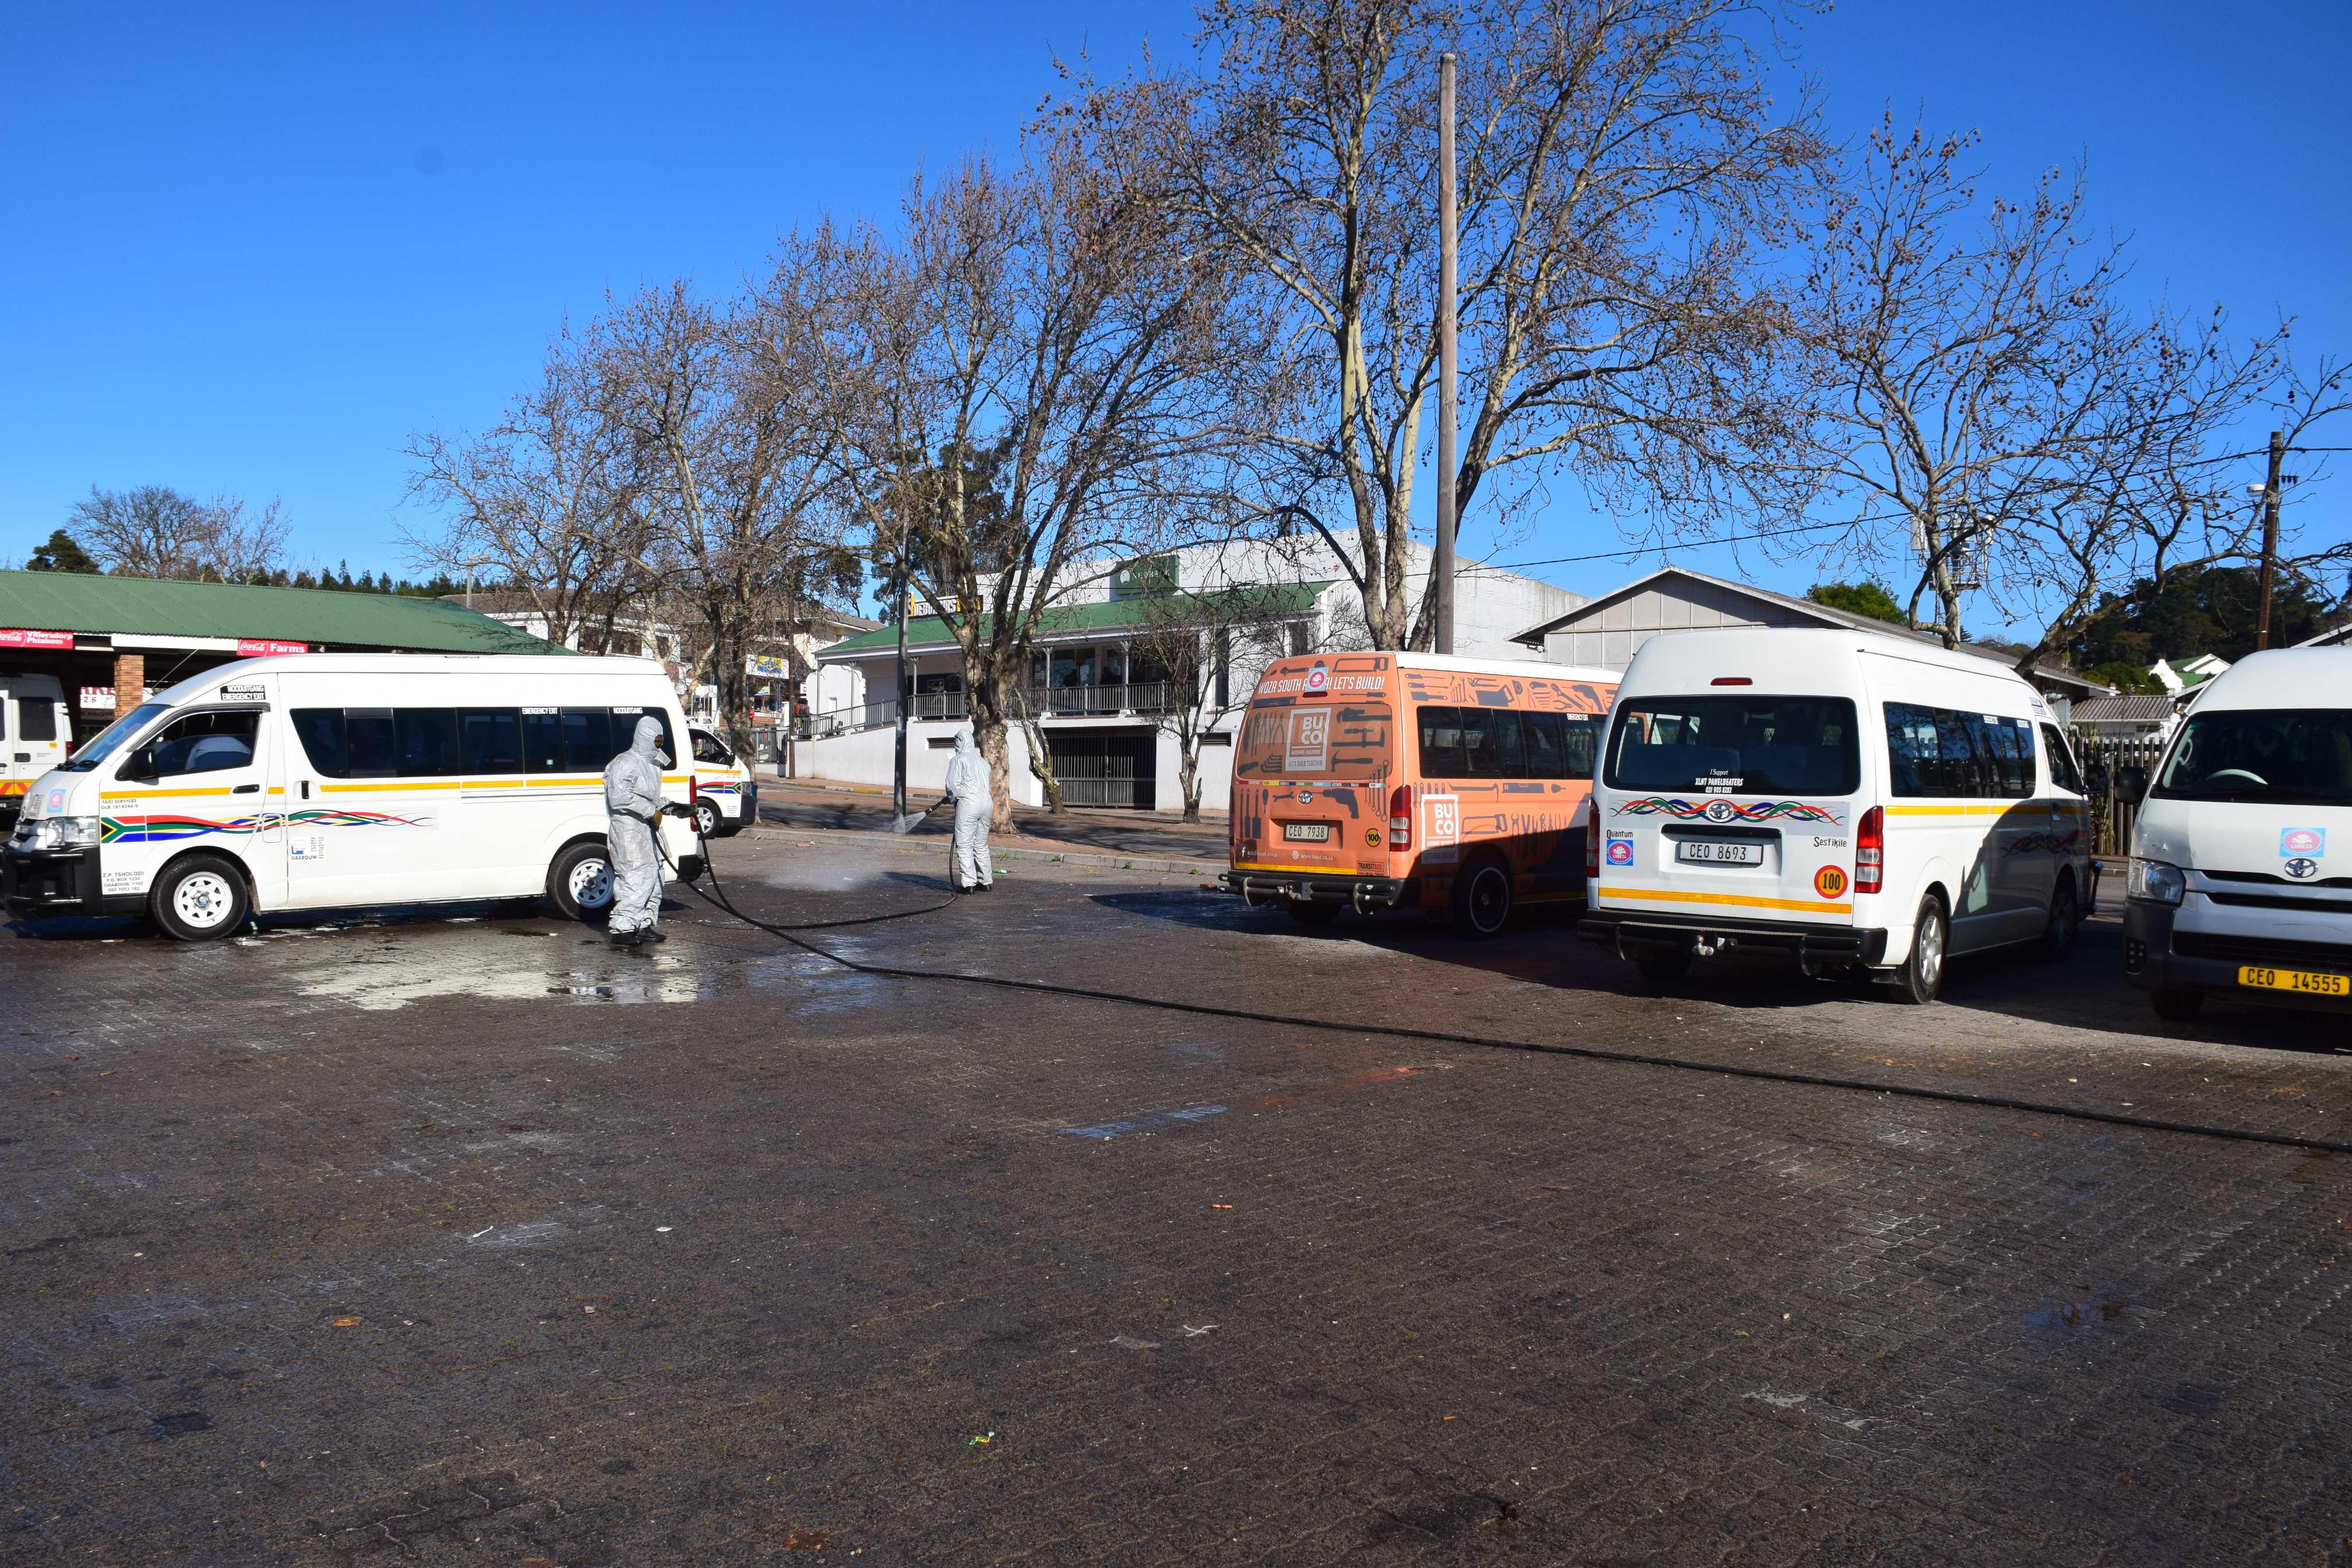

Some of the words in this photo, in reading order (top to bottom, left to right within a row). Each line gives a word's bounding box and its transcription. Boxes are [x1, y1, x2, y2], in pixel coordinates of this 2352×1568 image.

[1131, 569, 1170, 579] NEBAK
[914, 599, 957, 616] DEBORS
[241, 642, 266, 651] Coca-Cola
[270, 643, 305, 653] Farms
[1258, 680, 1277, 694] WOZA
[1278, 679, 1302, 692] SOUTH
[1333, 676, 1355, 690] LET'S
[1355, 676, 1385, 690] BUILD!
[1708, 778, 1743, 786] PANELBEATERS
[1434, 803, 1453, 819] BU
[1289, 827, 1302, 837] CEO
[1307, 827, 1325, 838] 7938
[1435, 819, 1454, 835] CO
[1367, 834, 1379, 842] 100
[1607, 830, 1633, 839] Quantum
[1690, 844, 1710, 858] CEO
[1717, 846, 1747, 861] 8693
[1823, 873, 1841, 891] 100
[2247, 968, 2275, 986] CEO
[2292, 973, 2341, 993] 14555
